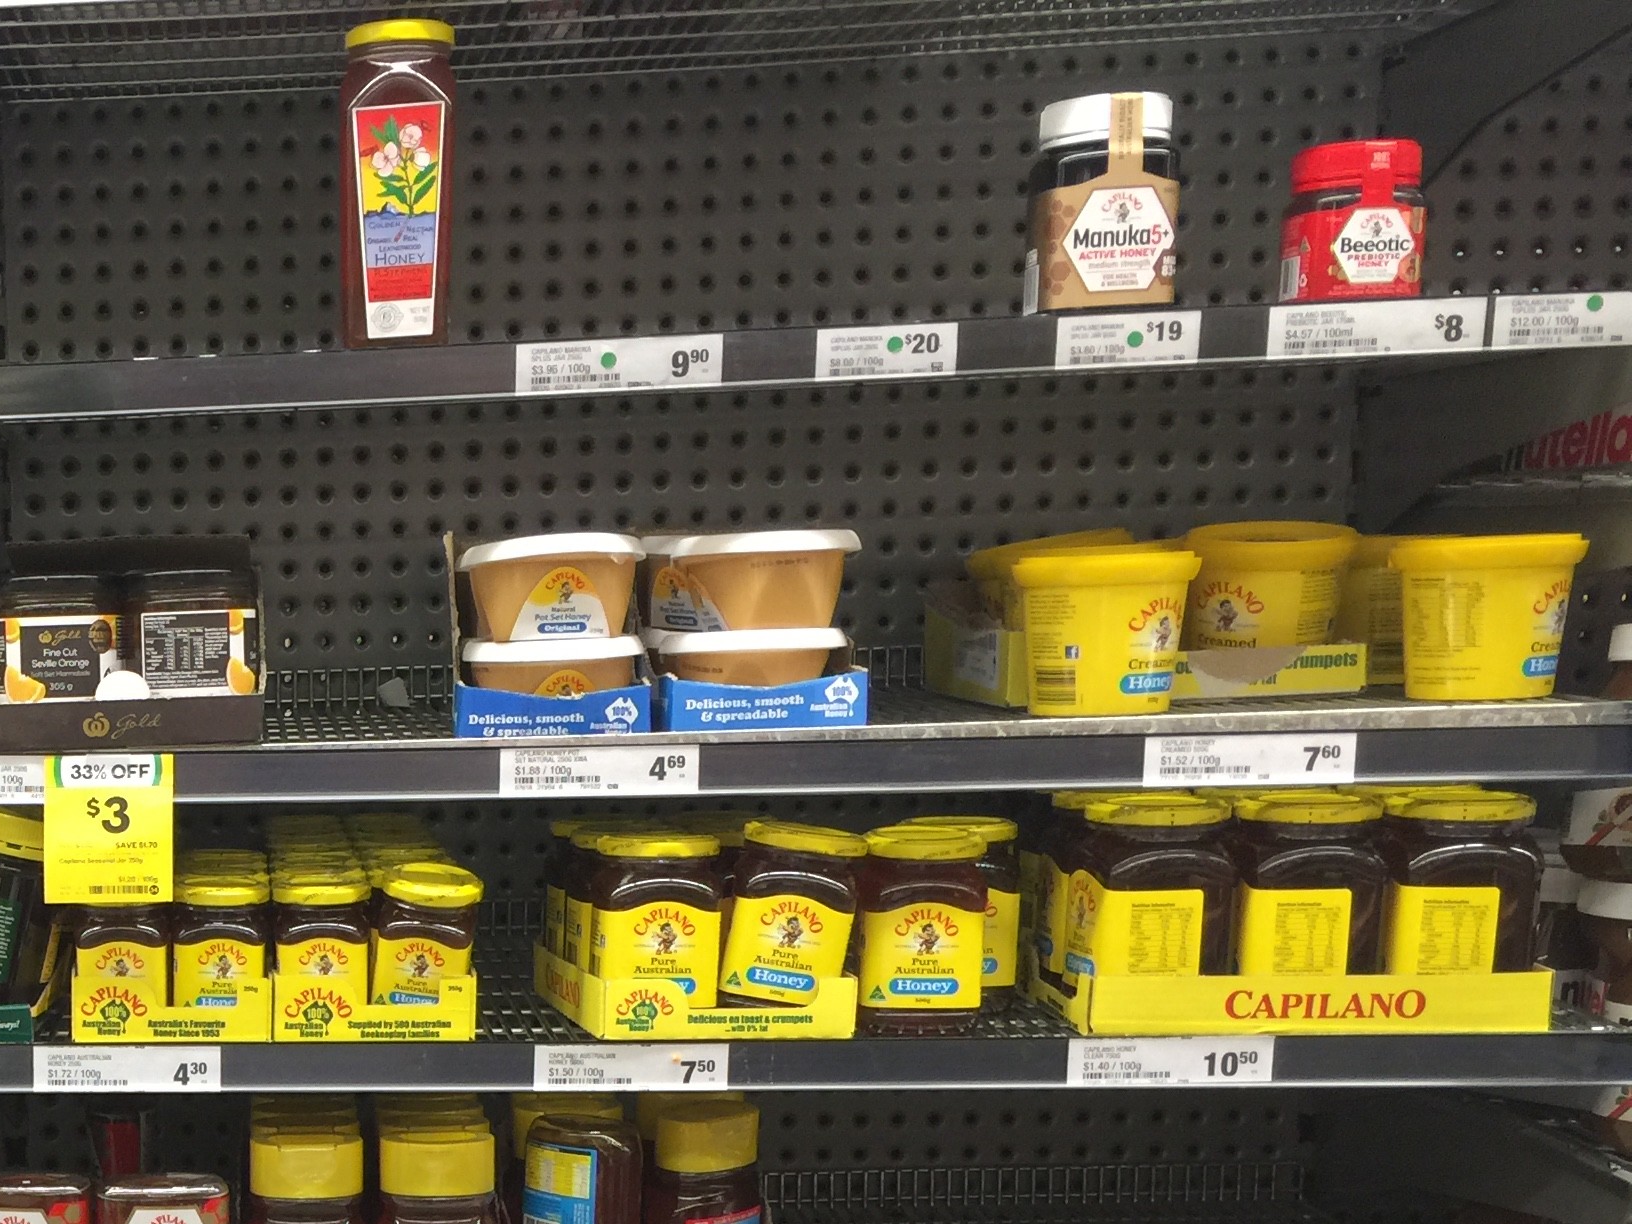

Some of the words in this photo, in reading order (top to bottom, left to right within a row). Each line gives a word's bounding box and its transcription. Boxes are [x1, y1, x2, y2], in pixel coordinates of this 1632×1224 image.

[1340, 235, 1410, 255] Beeotic
[374, 250, 426, 266] HONEY
[1079, 249, 1116, 261] ACTIVE
[1120, 247, 1156, 260] HONEY
[1347, 253, 1400, 262] PREBIOTIC
[1147, 320, 1182, 342] $19
[1435, 314, 1463, 343] $8
[905, 332, 940, 354] $20
[43, 647, 59, 656] Fine
[62, 647, 77, 656] Cut
[31, 658, 58, 669] Seville
[60, 658, 90, 670] Orange
[754, 695, 804, 708] smooth
[701, 710, 712, 721] &
[714, 708, 789, 724] spreadable
[71, 765, 106, 780] 33%
[111, 763, 150, 779] OFF
[87, 796, 130, 834] $3
[894, 907, 960, 938] CAPILANO
[894, 965, 955, 975] Australian
[911, 957, 938, 968] Pure
[753, 968, 809, 990] Honey
[897, 978, 952, 995] Honey
[1225, 990, 1426, 1020] CAPILANO
